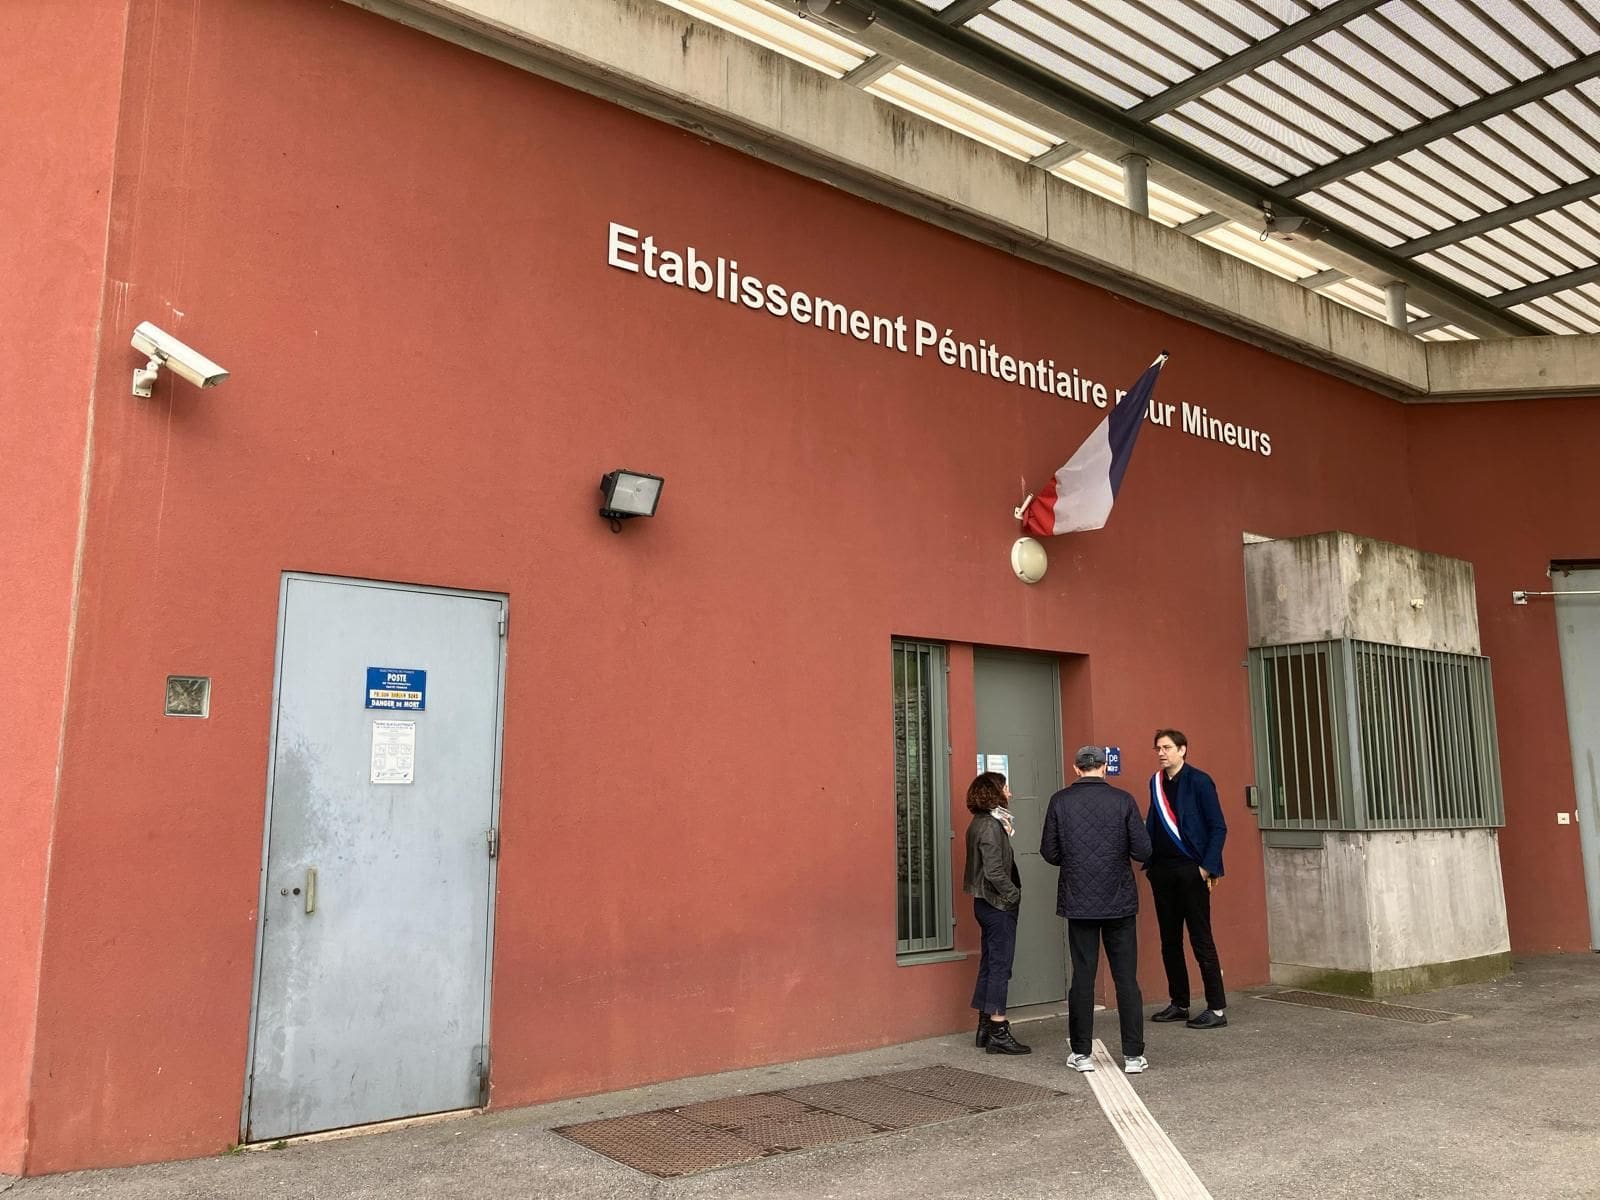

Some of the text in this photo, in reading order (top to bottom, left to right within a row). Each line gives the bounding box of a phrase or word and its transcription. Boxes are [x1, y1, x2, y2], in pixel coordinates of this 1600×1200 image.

[608, 221, 1272, 456] Etablissement Pénitentiaire ur Mineurs
[387, 673, 407, 682] POSTE
[371, 699, 395, 707] DANGER
